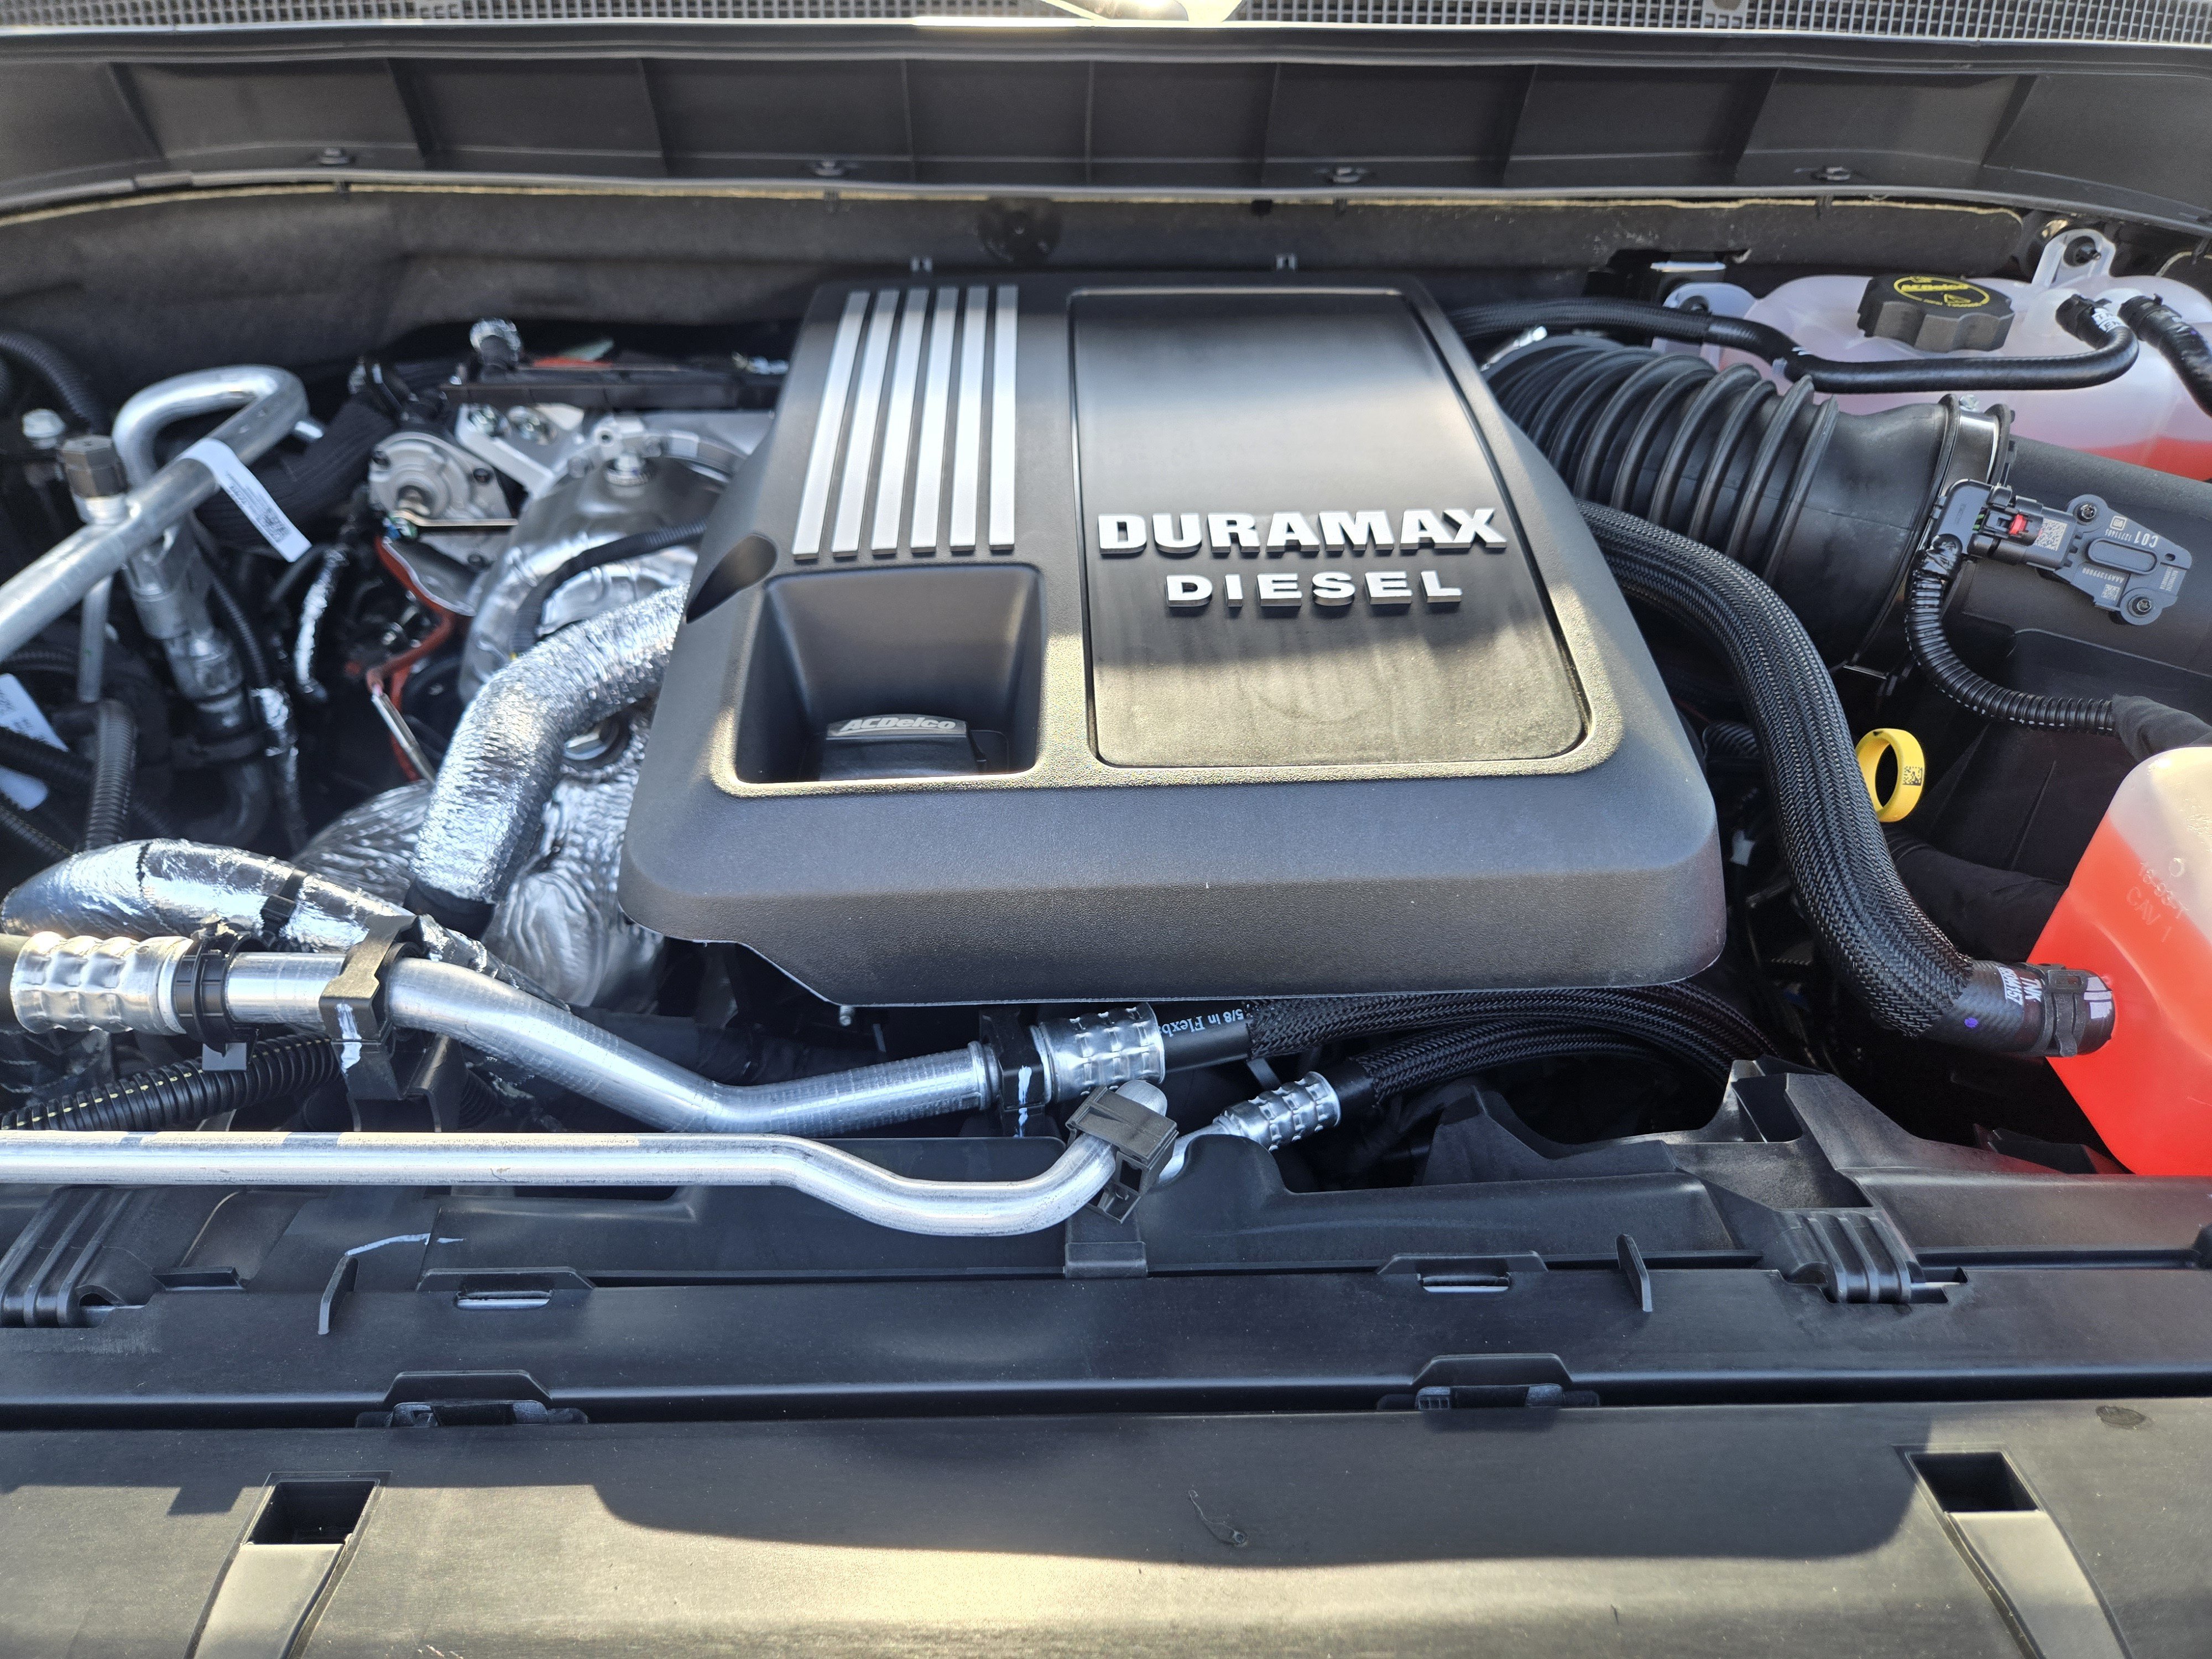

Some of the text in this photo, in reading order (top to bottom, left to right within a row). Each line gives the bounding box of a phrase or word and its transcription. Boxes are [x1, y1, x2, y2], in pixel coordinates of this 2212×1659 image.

[1098, 509, 1507, 554] DURAMAX
[2133, 531, 2159, 548] C01
[1166, 571, 1462, 607] DIESEL
[839, 717, 956, 732] ACDelco
[2126, 886, 2161, 926] CAV
[2019, 977, 2042, 1003] TNK
[1207, 1013, 1221, 1025] in
[1223, 1008, 1244, 1023] 5/8
